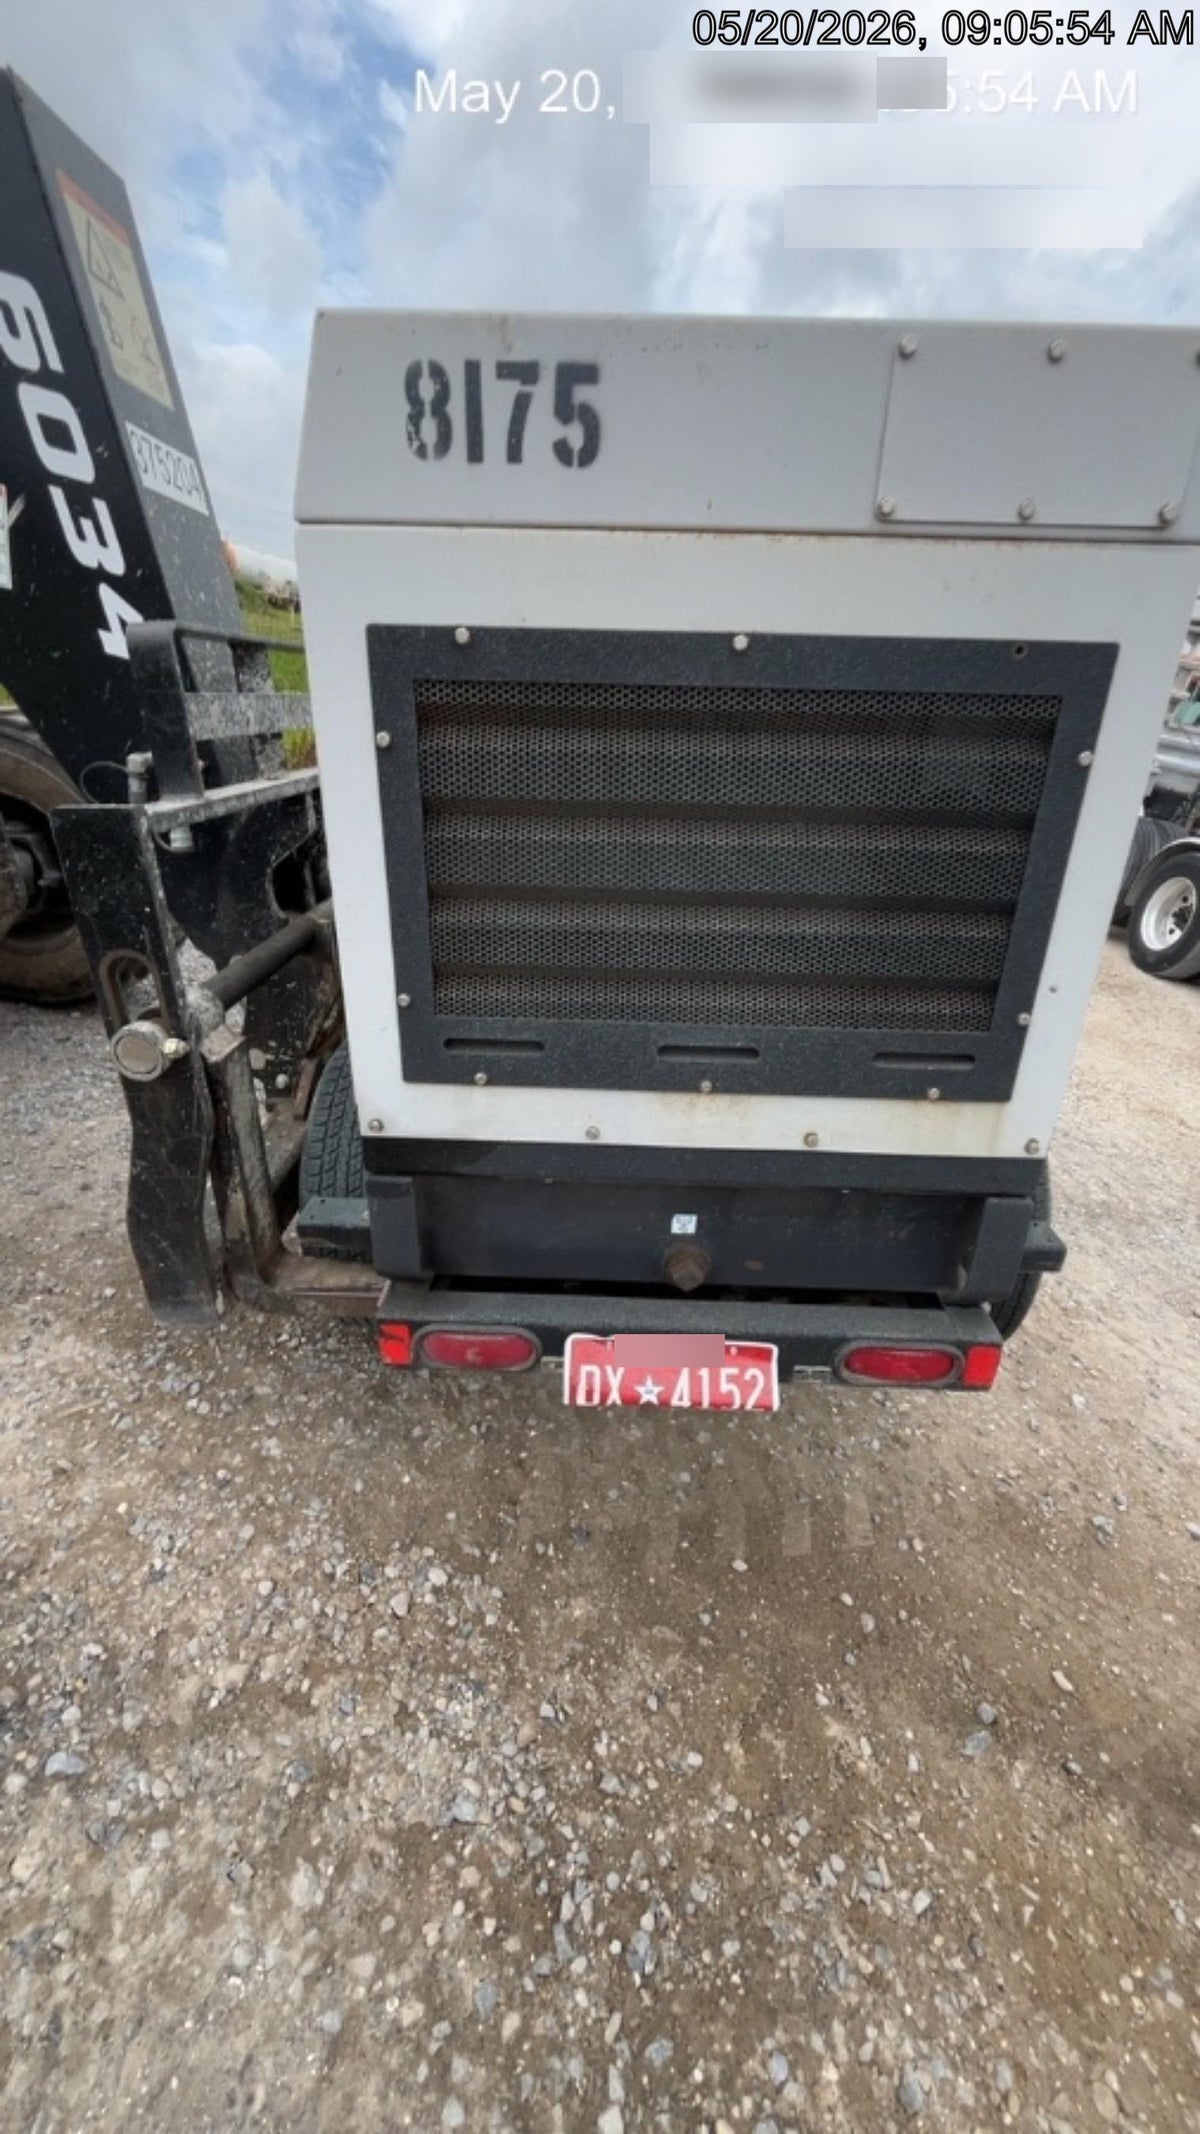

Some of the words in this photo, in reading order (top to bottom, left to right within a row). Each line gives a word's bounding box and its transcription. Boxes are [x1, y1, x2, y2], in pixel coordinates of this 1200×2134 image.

[0, 270, 143, 660] 6034
[404, 357, 602, 468] 8175
[576, 1364, 625, 1407] DX
[670, 1366, 766, 1412] 4152
